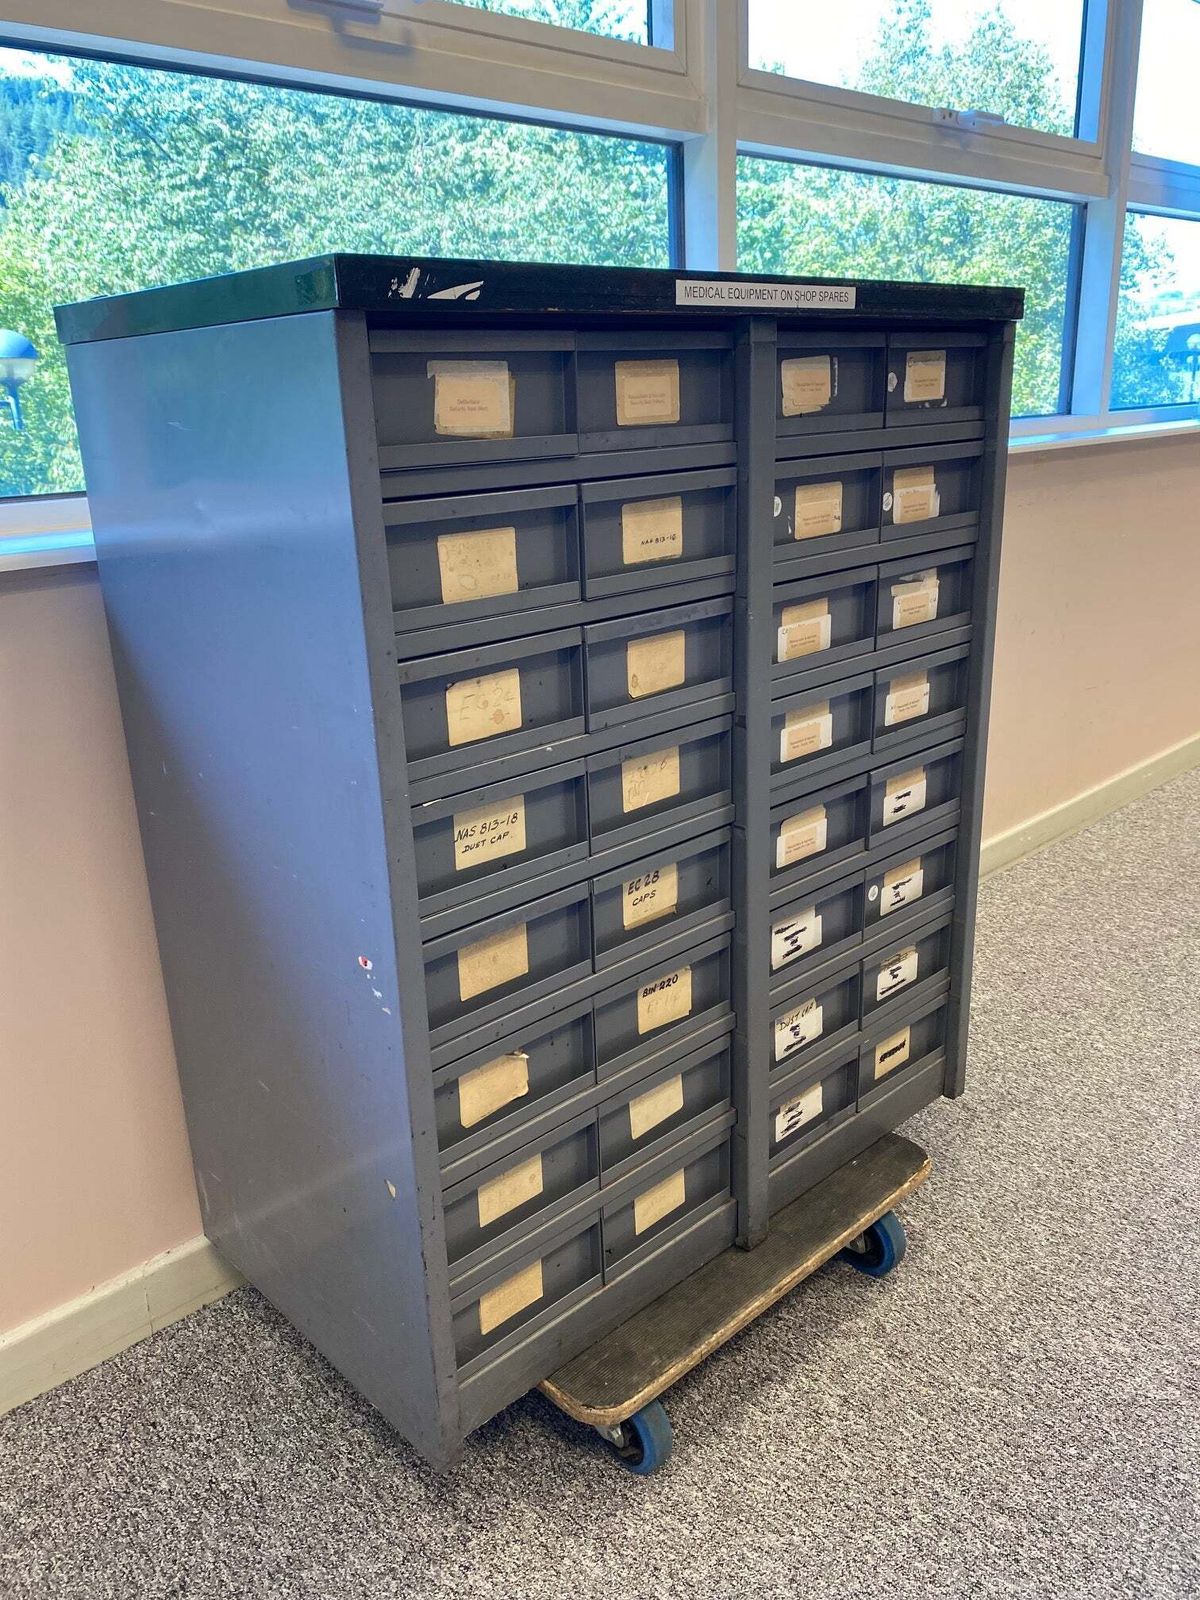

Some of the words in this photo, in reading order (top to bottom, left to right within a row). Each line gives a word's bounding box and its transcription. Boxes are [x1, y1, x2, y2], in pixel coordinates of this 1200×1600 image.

[684, 285, 725, 299] MEDICAL
[727, 287, 778, 301] EQUIPMENT
[780, 289, 793, 301] ON
[794, 290, 816, 302] SHOP
[818, 291, 849, 303] SPARES
[453, 825, 477, 844] NAS
[479, 812, 518, 835] 813-18
[462, 839, 487, 854] DUST
[490, 831, 510, 844] CAP
[627, 878, 642, 896] EC
[644, 870, 660, 887] 28
[632, 889, 657, 906] CAPS
